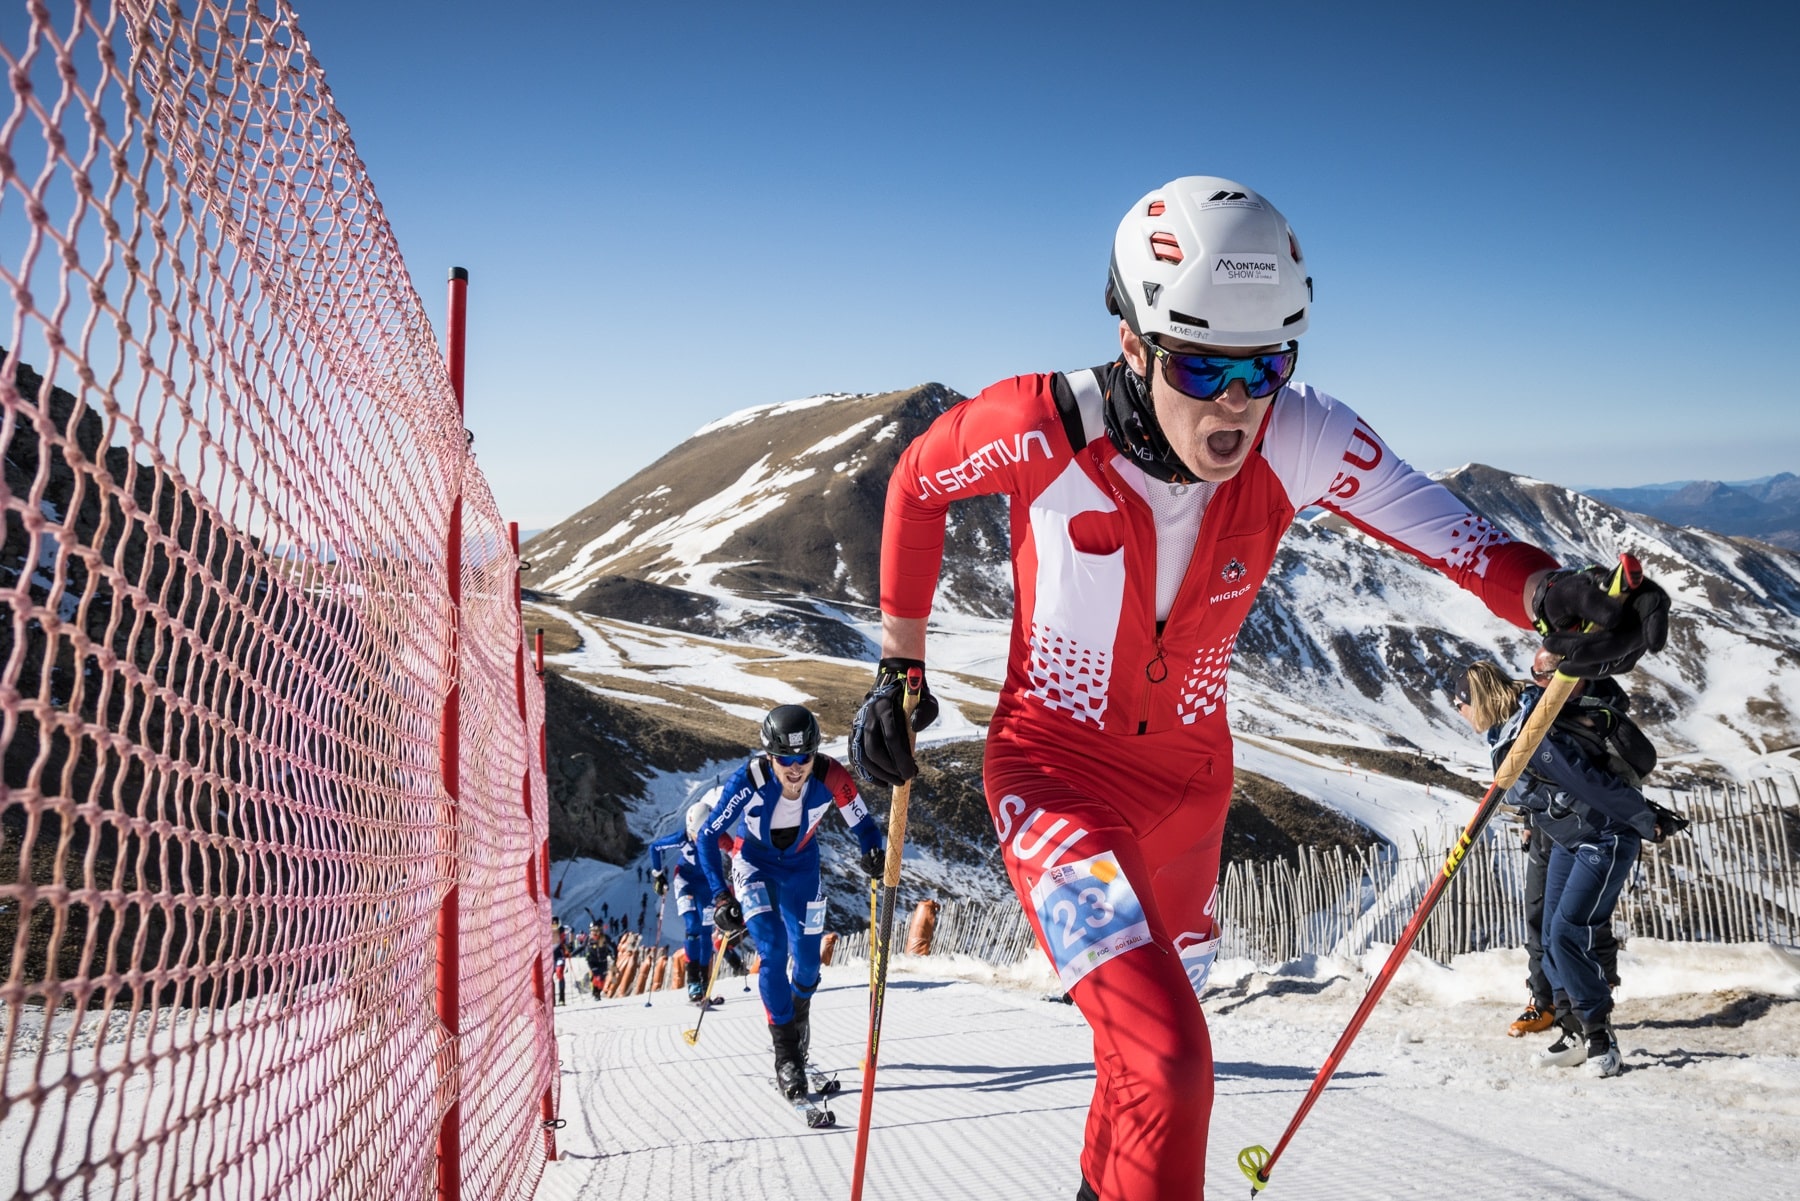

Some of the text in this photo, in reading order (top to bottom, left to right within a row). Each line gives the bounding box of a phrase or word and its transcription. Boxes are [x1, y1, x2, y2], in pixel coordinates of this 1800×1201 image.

[1215, 258, 1277, 271] MONTAGNE
[1228, 270, 1254, 279] SHOW
[936, 430, 1054, 492] SPORTIVA
[1210, 583, 1251, 605] MIGROS
[711, 787, 752, 831] SPORTIVA
[995, 794, 1089, 870] SUI
[1052, 887, 1115, 949] 23
